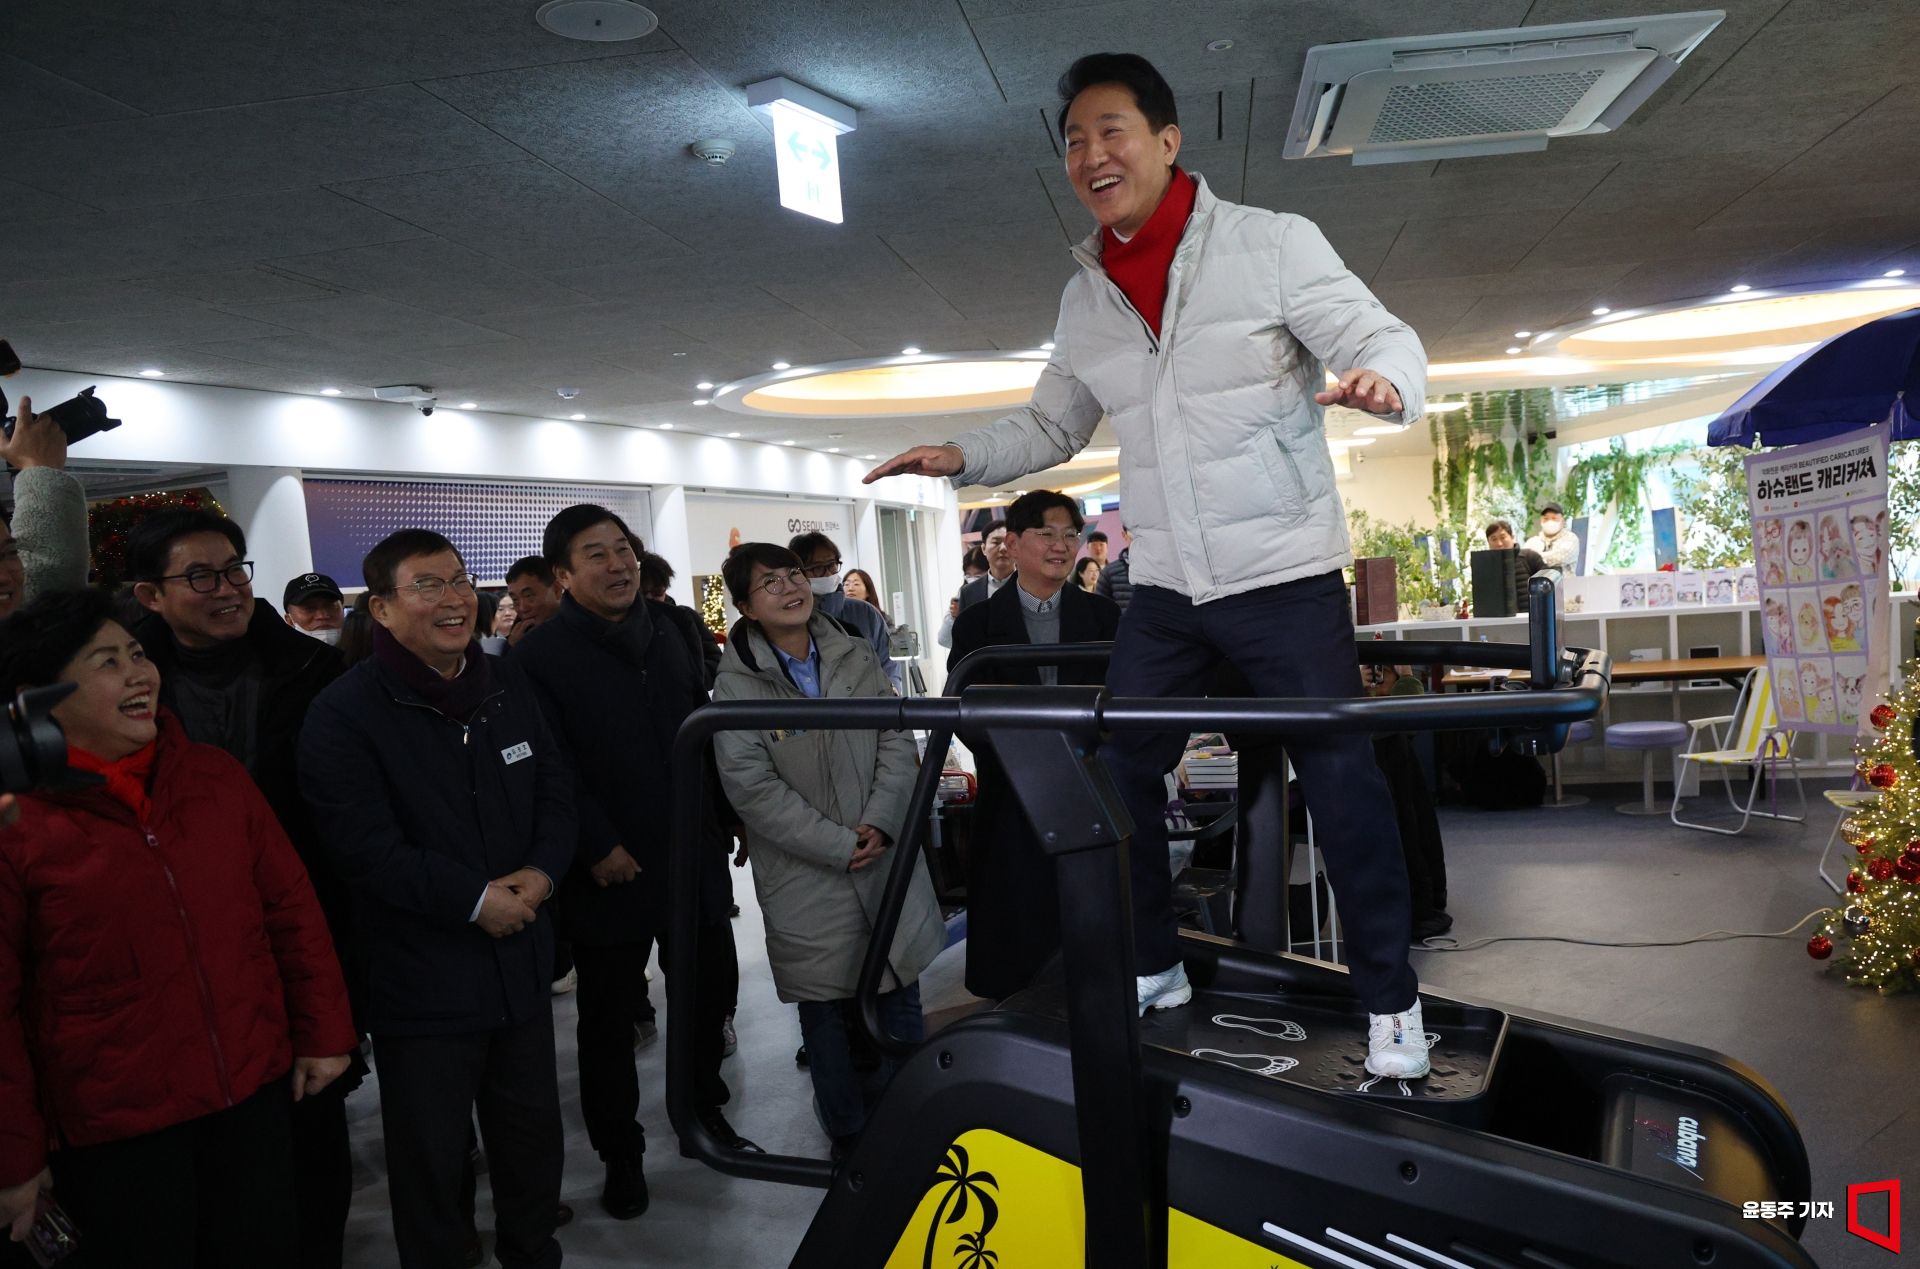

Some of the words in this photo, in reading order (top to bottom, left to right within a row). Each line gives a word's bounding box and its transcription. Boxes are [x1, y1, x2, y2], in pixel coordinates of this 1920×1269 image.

[1799, 455, 1829, 468] BEAUTIFIED
[1829, 446, 1870, 461] CARICATURES
[1757, 472, 1814, 499] 하슈랜드
[1817, 456, 1877, 489] 캐리커쳐
[788, 518, 802, 533] GO
[802, 520, 825, 532] SEOUL
